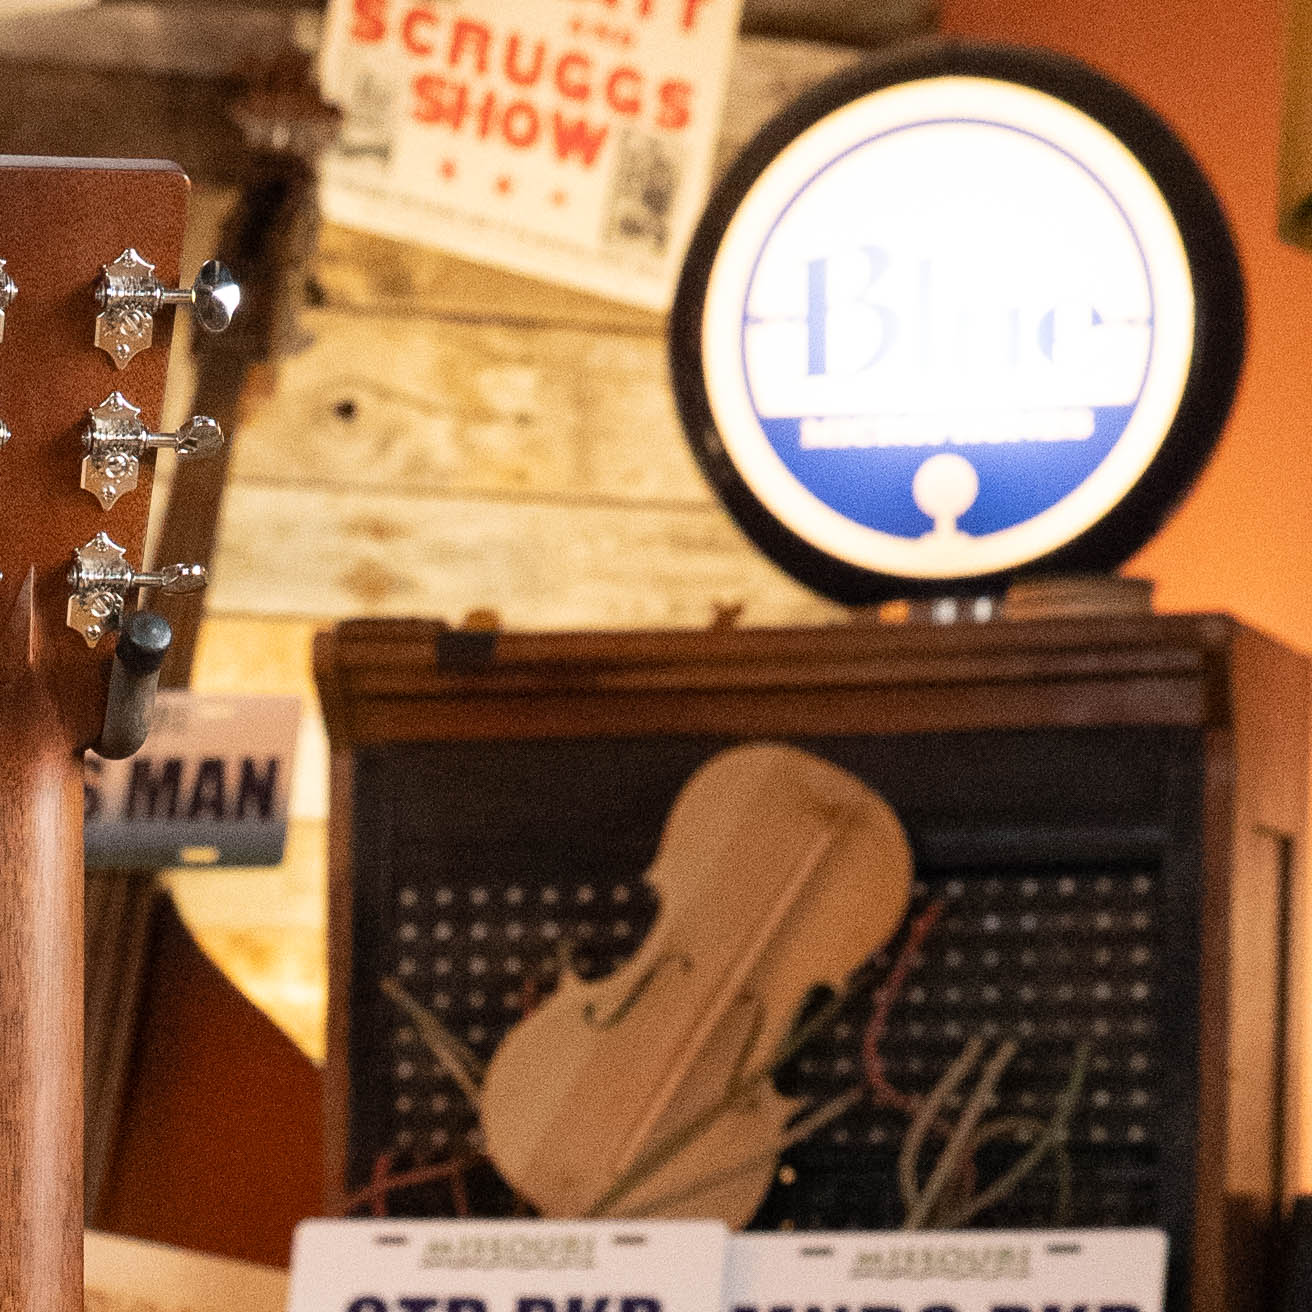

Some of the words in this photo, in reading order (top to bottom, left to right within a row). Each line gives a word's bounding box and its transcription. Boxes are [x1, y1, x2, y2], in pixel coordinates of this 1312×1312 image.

[351, 0, 693, 132] SCRUGGS
[410, 74, 609, 170] SHOW
[121, 755, 280, 822] MAN
